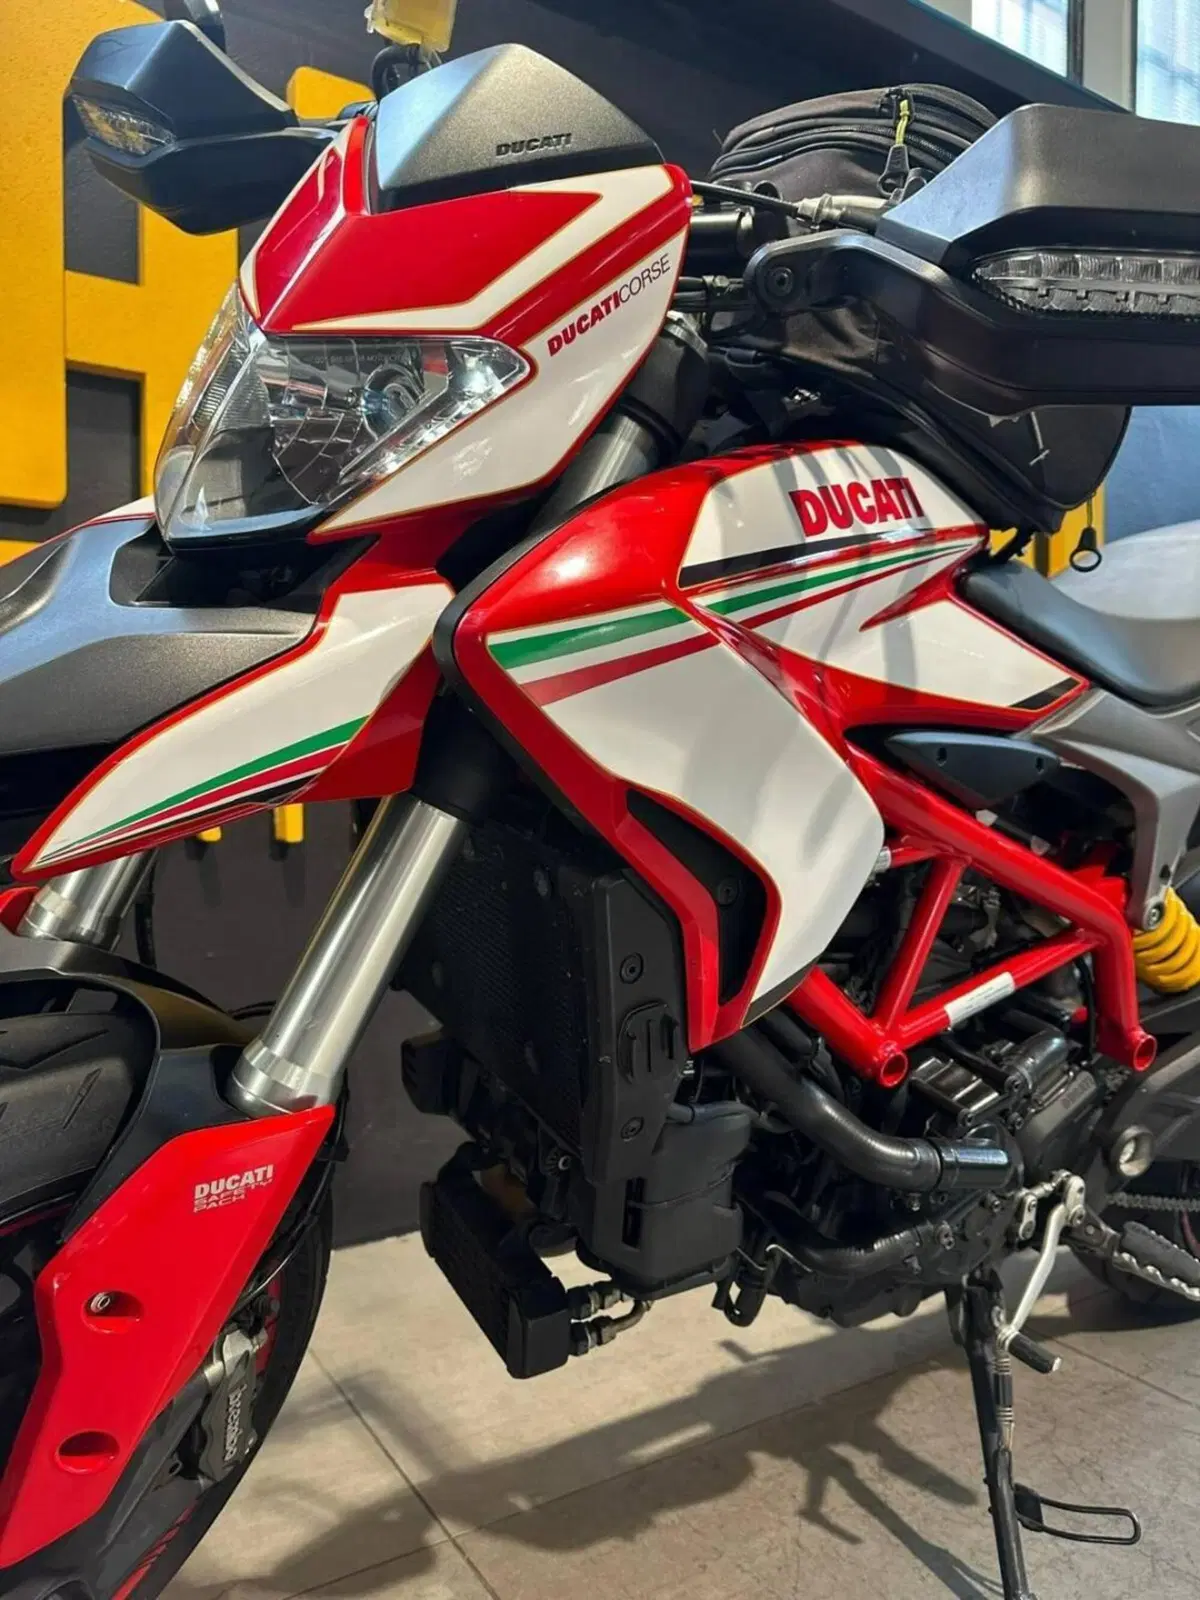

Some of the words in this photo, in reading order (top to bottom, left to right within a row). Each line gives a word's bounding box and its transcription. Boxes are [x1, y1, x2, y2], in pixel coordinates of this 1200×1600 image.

[495, 132, 573, 156] DUCATI
[788, 476, 926, 537] DUCATI
[194, 1163, 274, 1200] DUCATI
